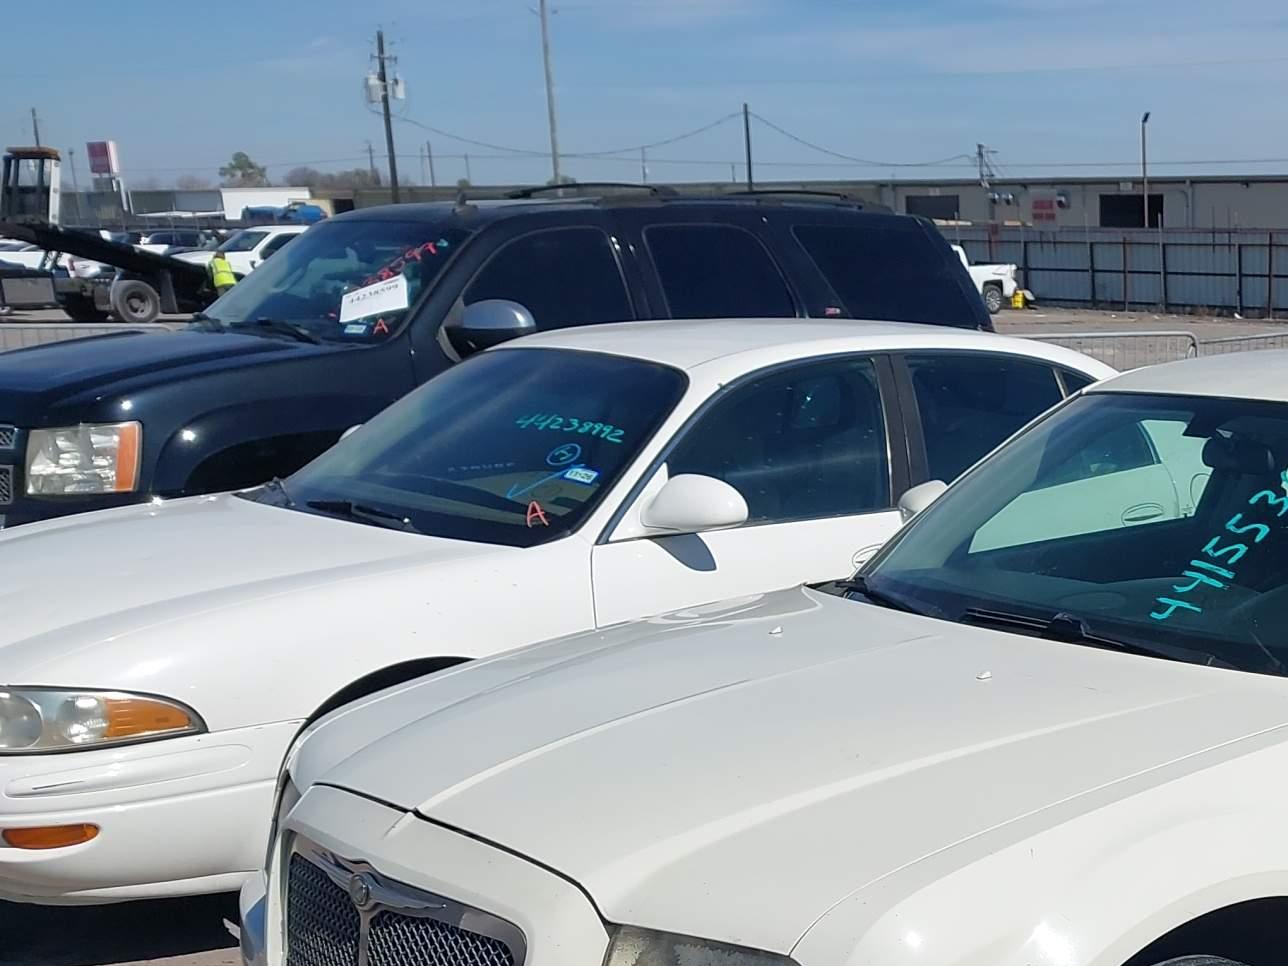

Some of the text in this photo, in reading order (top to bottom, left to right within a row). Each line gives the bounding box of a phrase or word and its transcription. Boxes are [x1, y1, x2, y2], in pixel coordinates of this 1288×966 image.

[373, 318, 389, 335] A
[516, 414, 625, 444] 44238992
[526, 500, 550, 528] A
